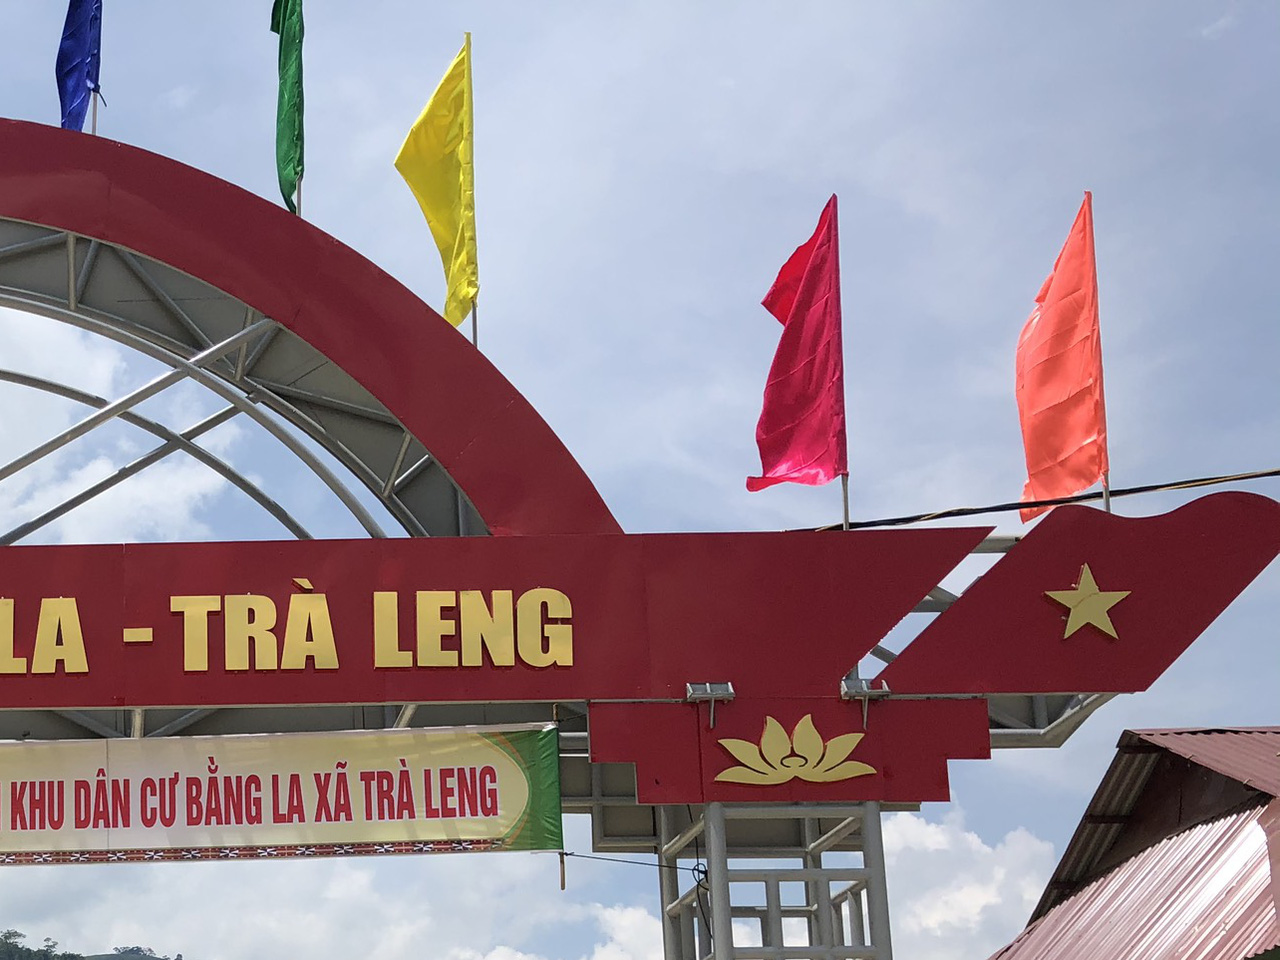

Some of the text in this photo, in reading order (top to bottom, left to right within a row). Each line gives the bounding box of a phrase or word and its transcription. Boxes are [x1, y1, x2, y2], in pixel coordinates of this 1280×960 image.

[373, 587, 573, 669] LENG
[10, 780, 65, 832] KHU
[74, 768, 131, 830] DÂN
[140, 770, 180, 829] CƯ
[185, 756, 263, 828] BẰNG
[271, 773, 303, 825] LA
[313, 761, 353, 824] XÃ
[360, 758, 416, 822] TRÀ
[423, 765, 499, 819] LENG
